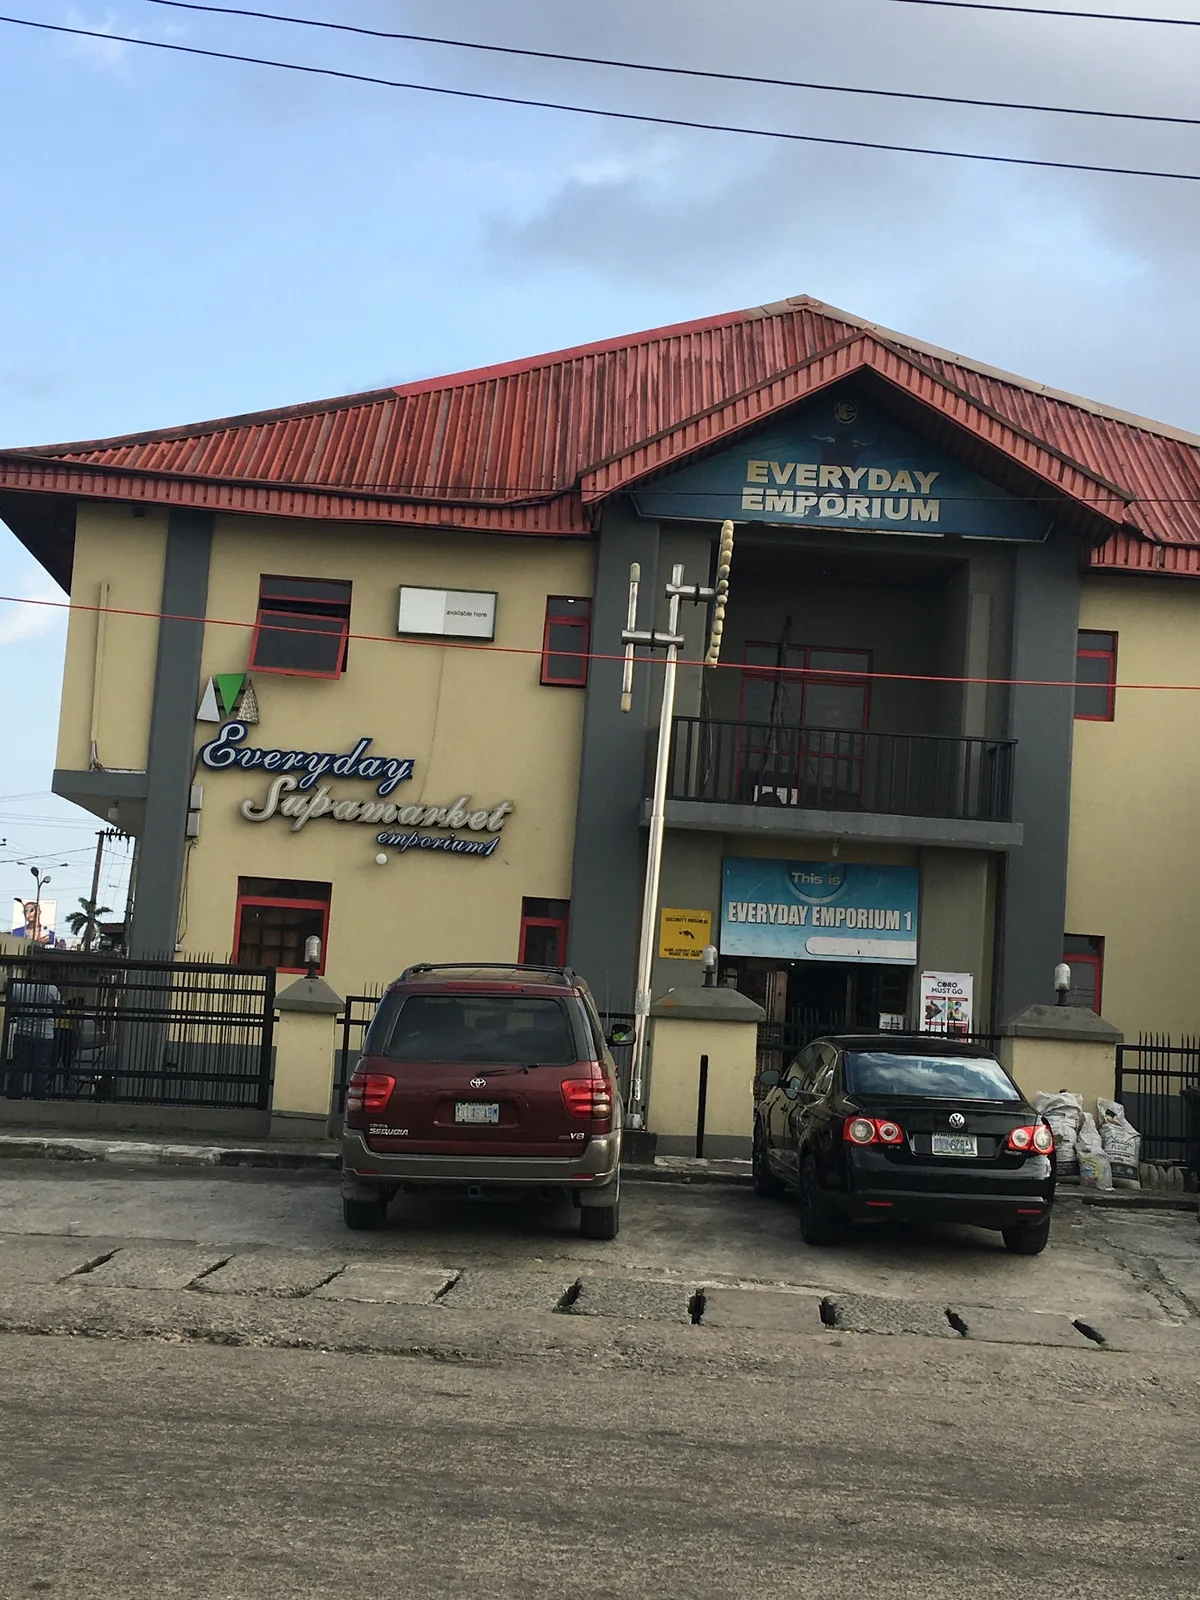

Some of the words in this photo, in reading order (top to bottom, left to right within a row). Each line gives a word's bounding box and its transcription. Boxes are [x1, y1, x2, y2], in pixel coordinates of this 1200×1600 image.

[746, 460, 940, 494] EVERYDAY
[742, 487, 940, 522] EMPORIUM
[202, 721, 413, 796] Everyday
[240, 774, 514, 832] Supamarket
[791, 872, 823, 885] This
[828, 874, 842, 885] is
[728, 902, 809, 927] EVERYDAY
[811, 907, 900, 931] EMPORIUM
[903, 911, 912, 932] 1
[369, 1127, 409, 1136] SEQUOIA
[570, 1132, 585, 1140] V8
